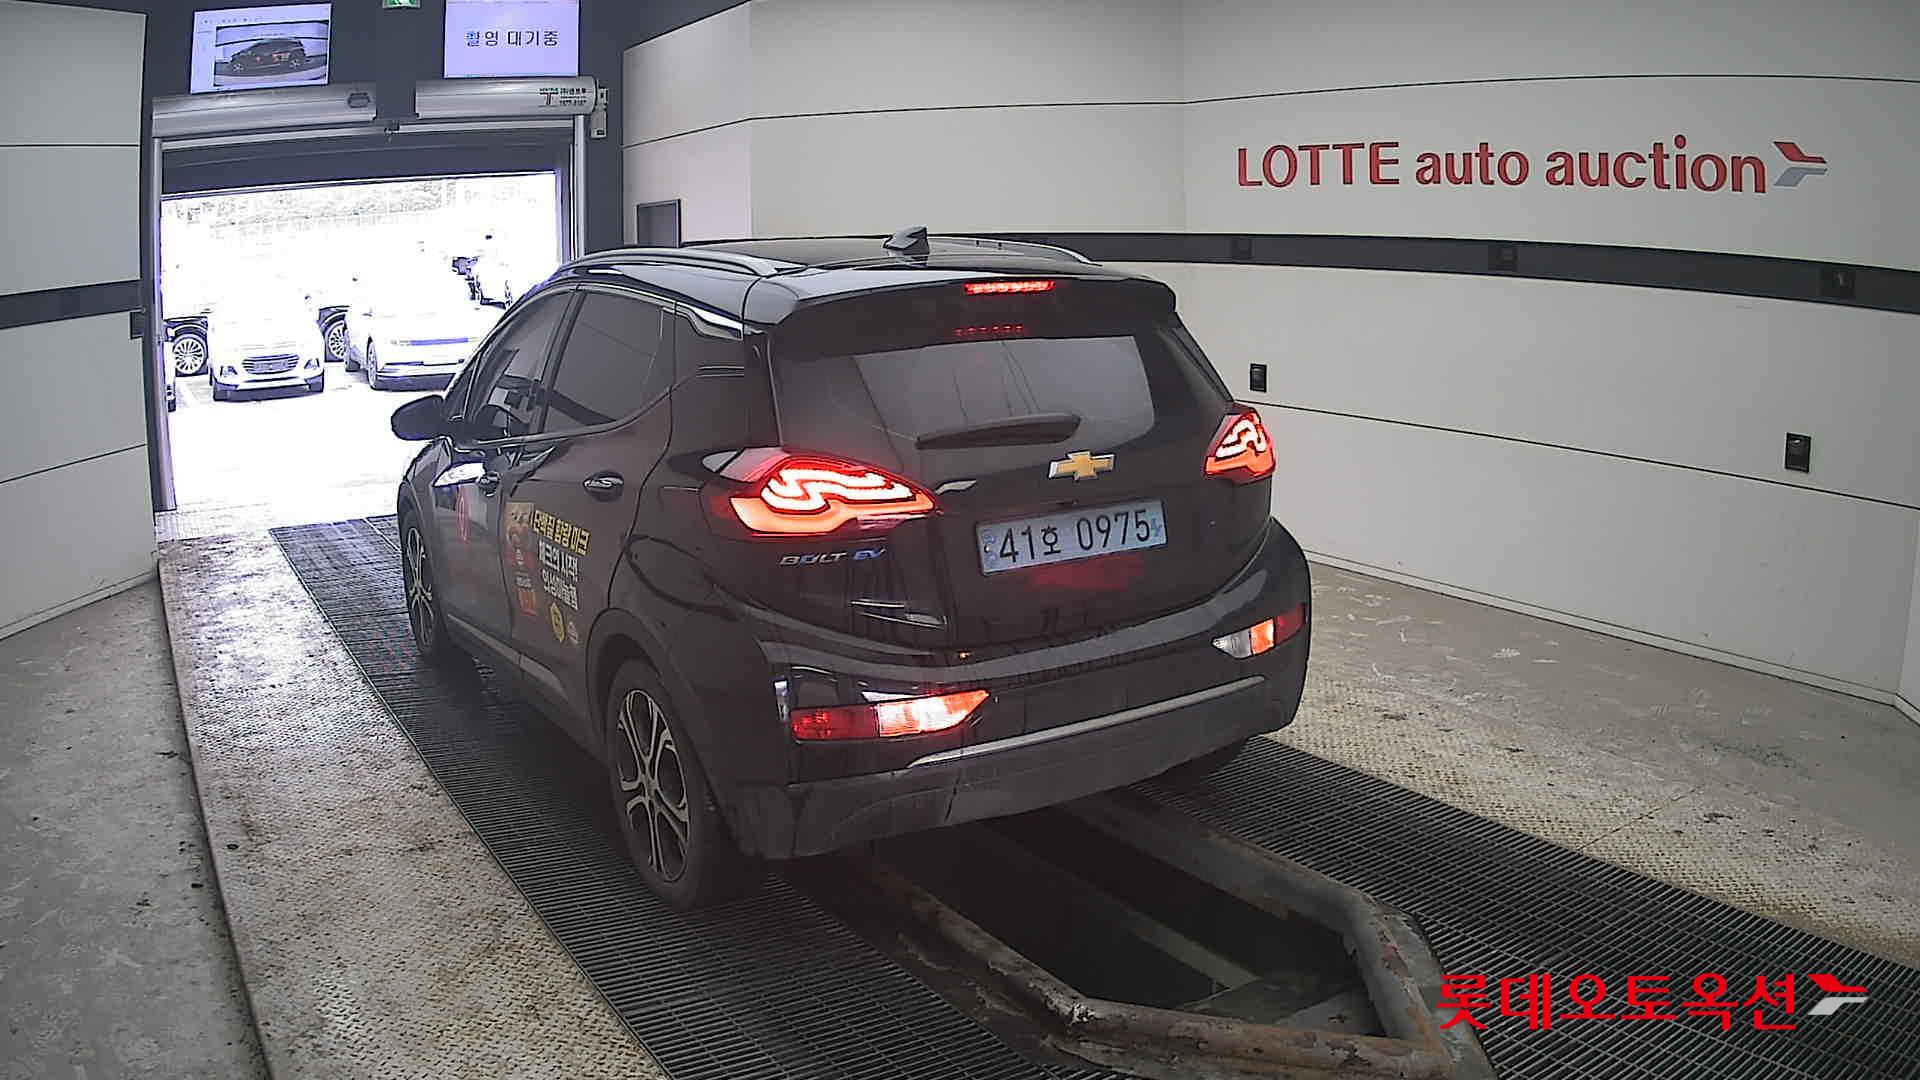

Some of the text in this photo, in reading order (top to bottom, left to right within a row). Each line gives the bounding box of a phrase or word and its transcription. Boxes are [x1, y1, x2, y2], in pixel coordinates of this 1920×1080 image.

[507, 31, 558, 47] 대기중
[1237, 134, 1767, 194] LOTTE auto auction
[999, 508, 1151, 563] 41호 0975
[780, 549, 886, 566] BOLT EV
